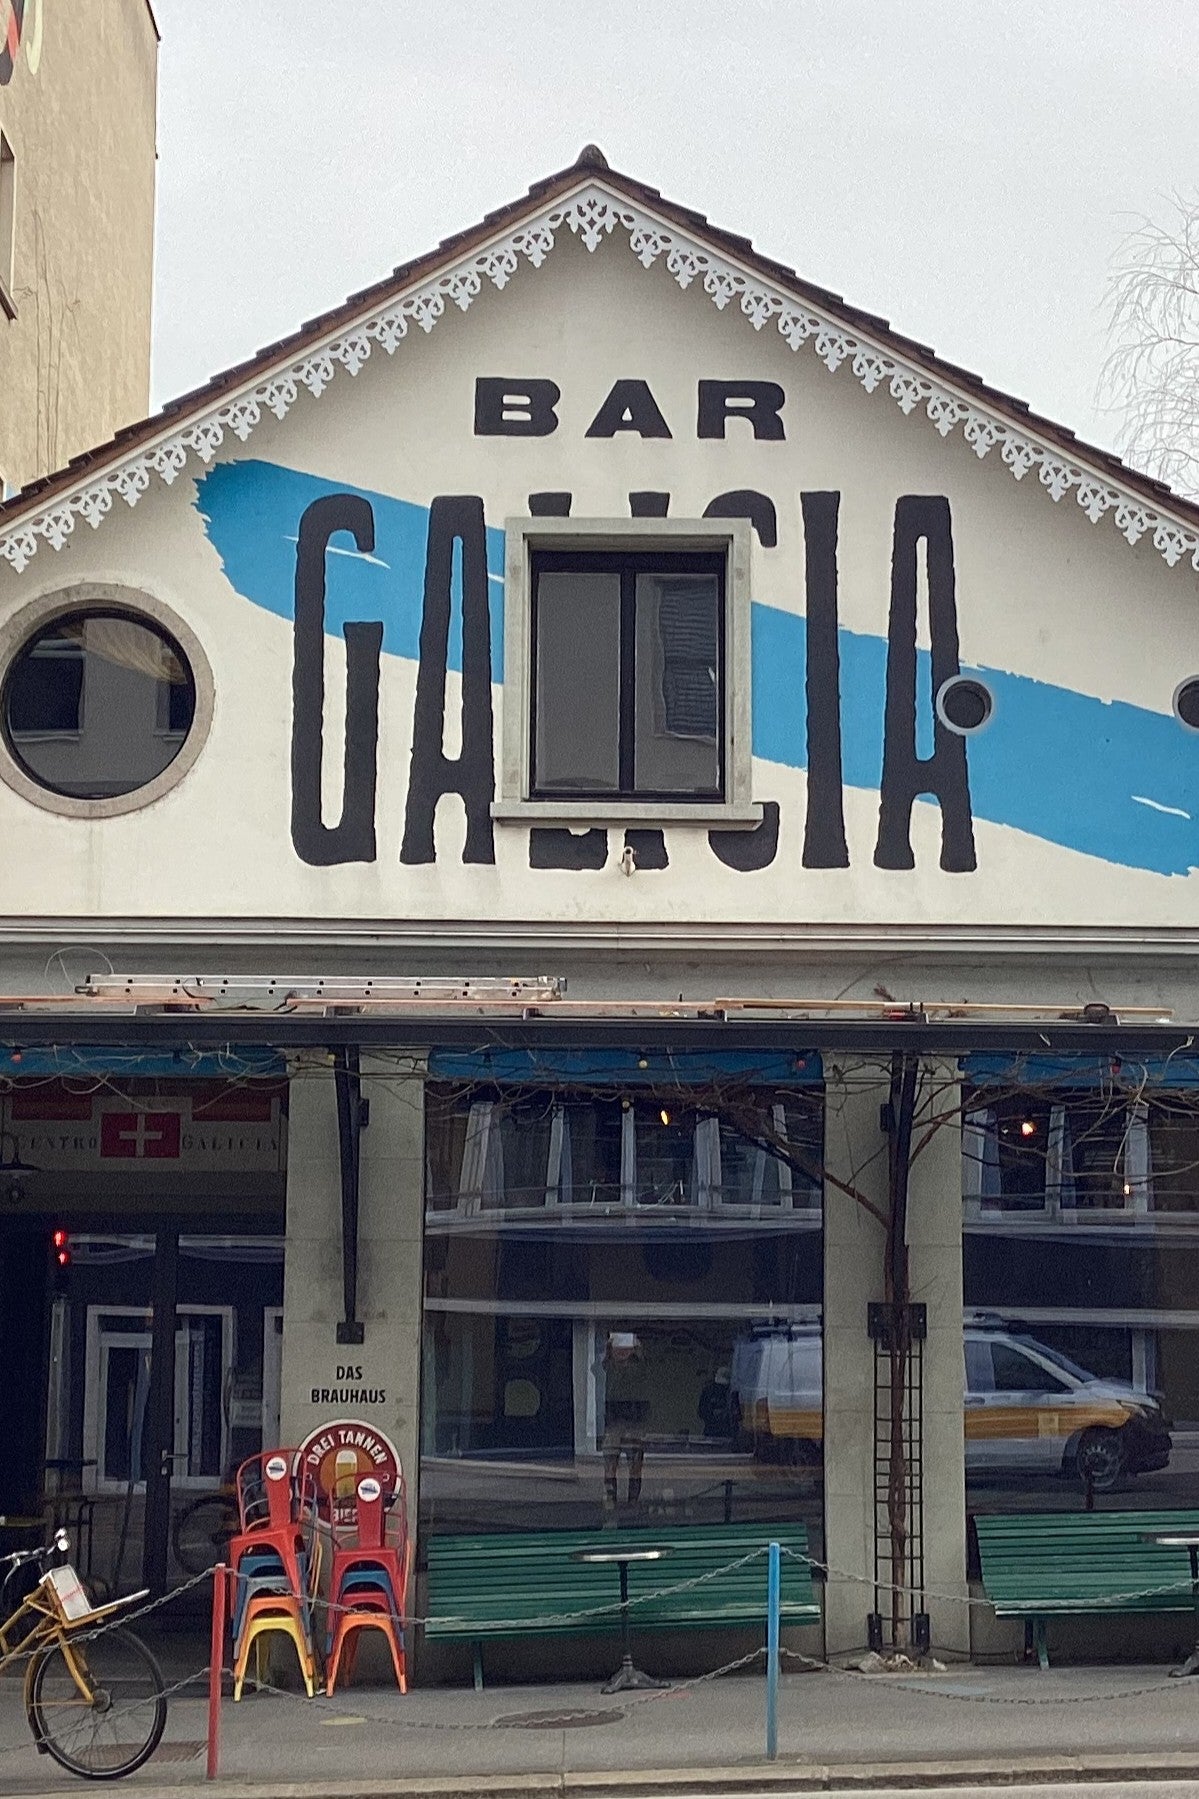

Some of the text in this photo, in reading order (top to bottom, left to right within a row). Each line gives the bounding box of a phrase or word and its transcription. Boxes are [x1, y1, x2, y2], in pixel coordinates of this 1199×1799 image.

[474, 377, 786, 440] BAR
[336, 1365, 363, 1381] DAS
[311, 1388, 386, 1404] BRAUHAUS
[307, 1430, 388, 1466] DREI TANNEN
